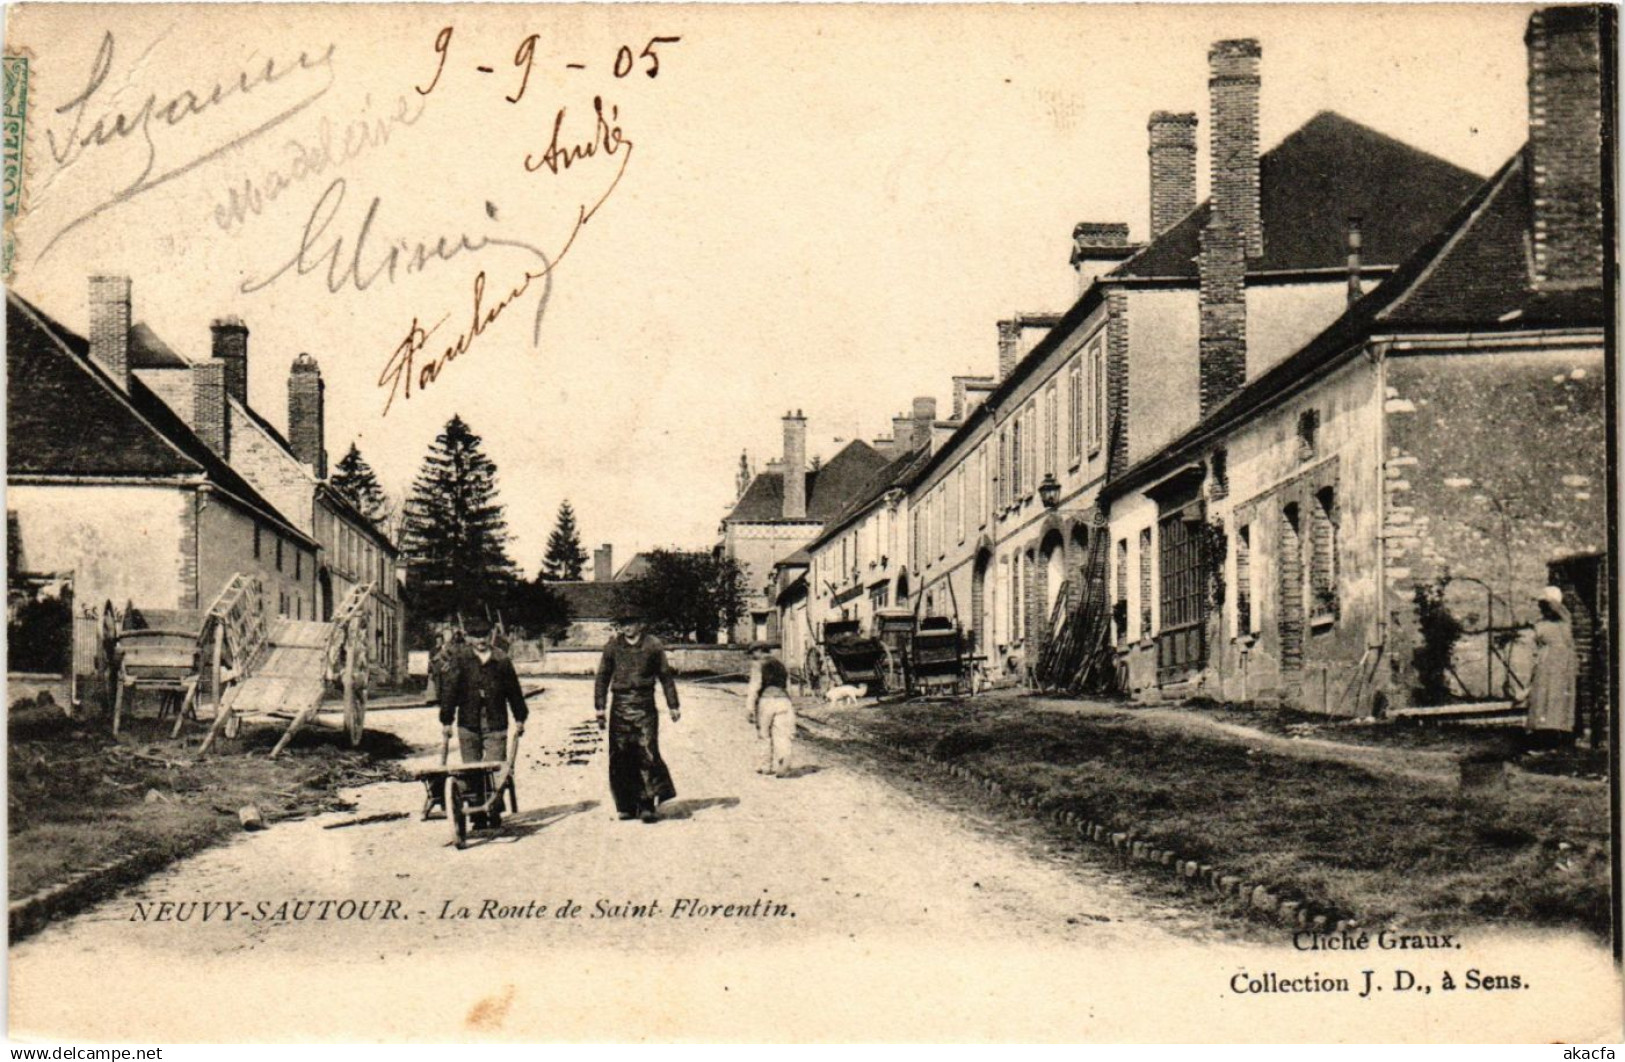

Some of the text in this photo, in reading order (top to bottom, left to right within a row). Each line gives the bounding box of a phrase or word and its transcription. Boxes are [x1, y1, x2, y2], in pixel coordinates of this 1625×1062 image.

[415, 27, 454, 95] 9
[505, 34, 541, 104] 9
[613, 37, 681, 79] 05
[524, 95, 633, 175] André
